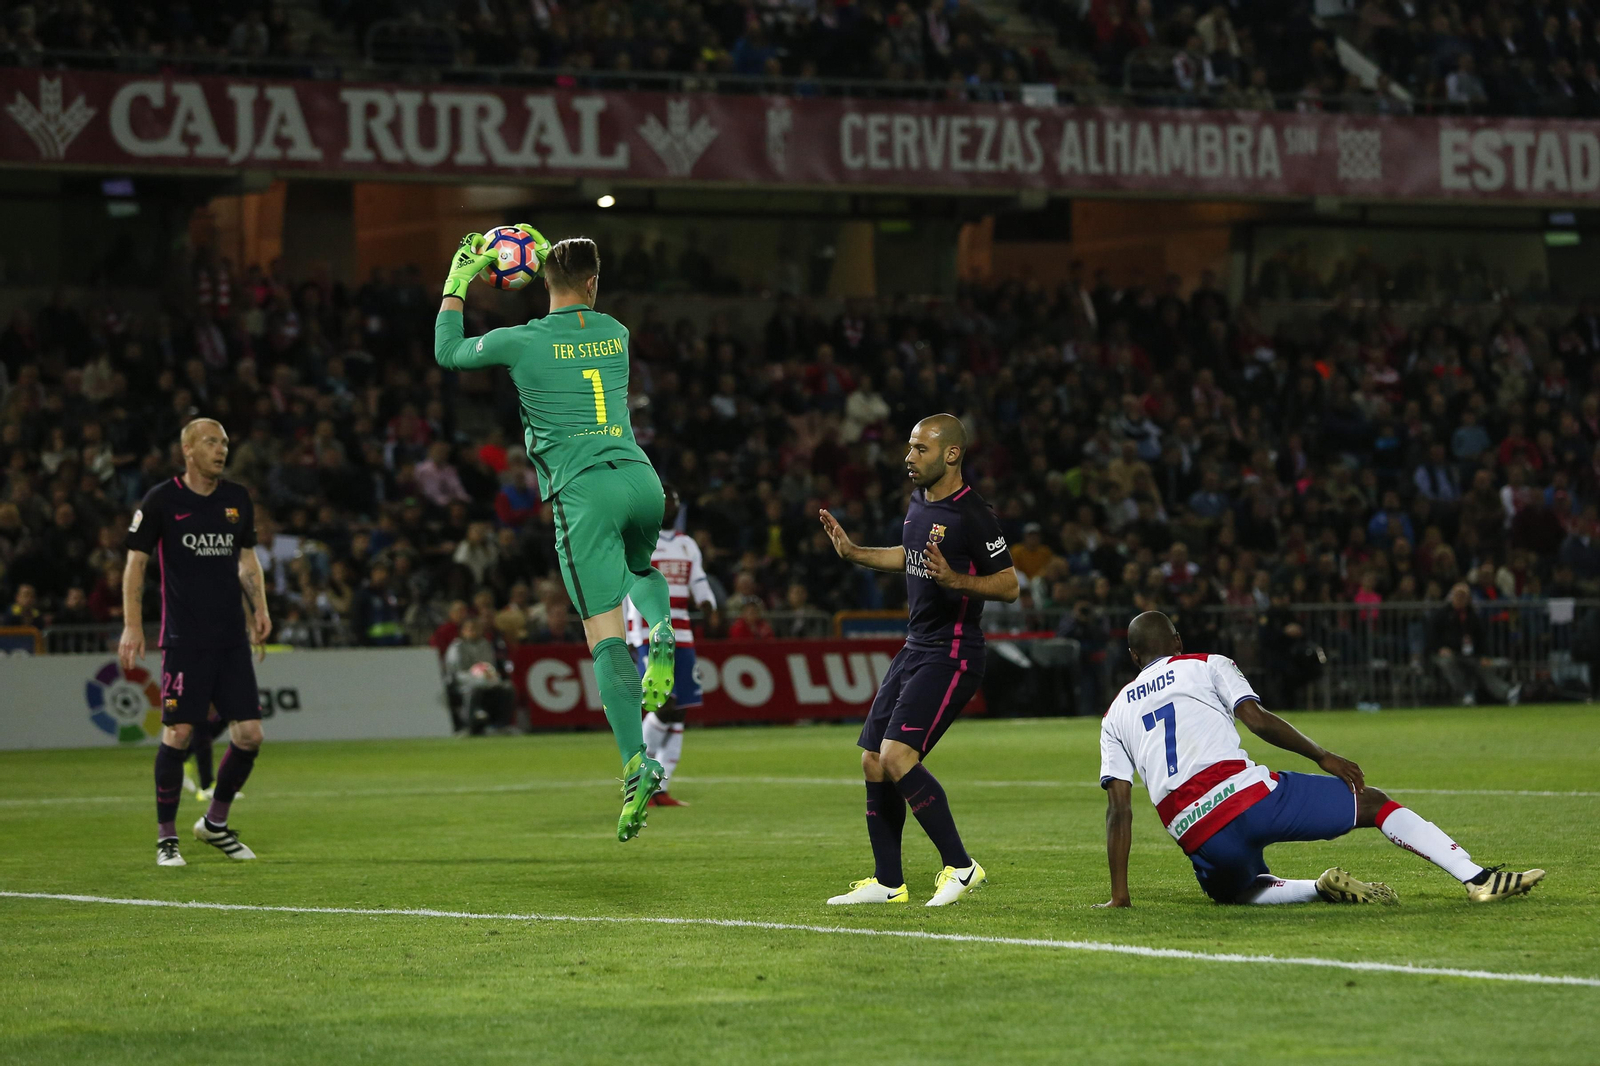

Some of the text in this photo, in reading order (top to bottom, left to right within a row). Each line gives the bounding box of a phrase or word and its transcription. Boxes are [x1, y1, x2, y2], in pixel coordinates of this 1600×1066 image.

[108, 81, 630, 170] CAJA RURAL
[840, 112, 1045, 175] CERVEZAS
[1058, 119, 1283, 180] ALHAMBRA
[1439, 128, 1600, 193] ESTAD
[552, 337, 624, 360] TER STEGEN
[581, 368, 607, 425] 1
[182, 533, 235, 550] QATAR
[906, 548, 930, 568] ATA
[907, 564, 936, 579] AIRWA
[163, 671, 185, 696] 24
[1126, 669, 1176, 703] RAMOS
[1142, 702, 1178, 778] 7
